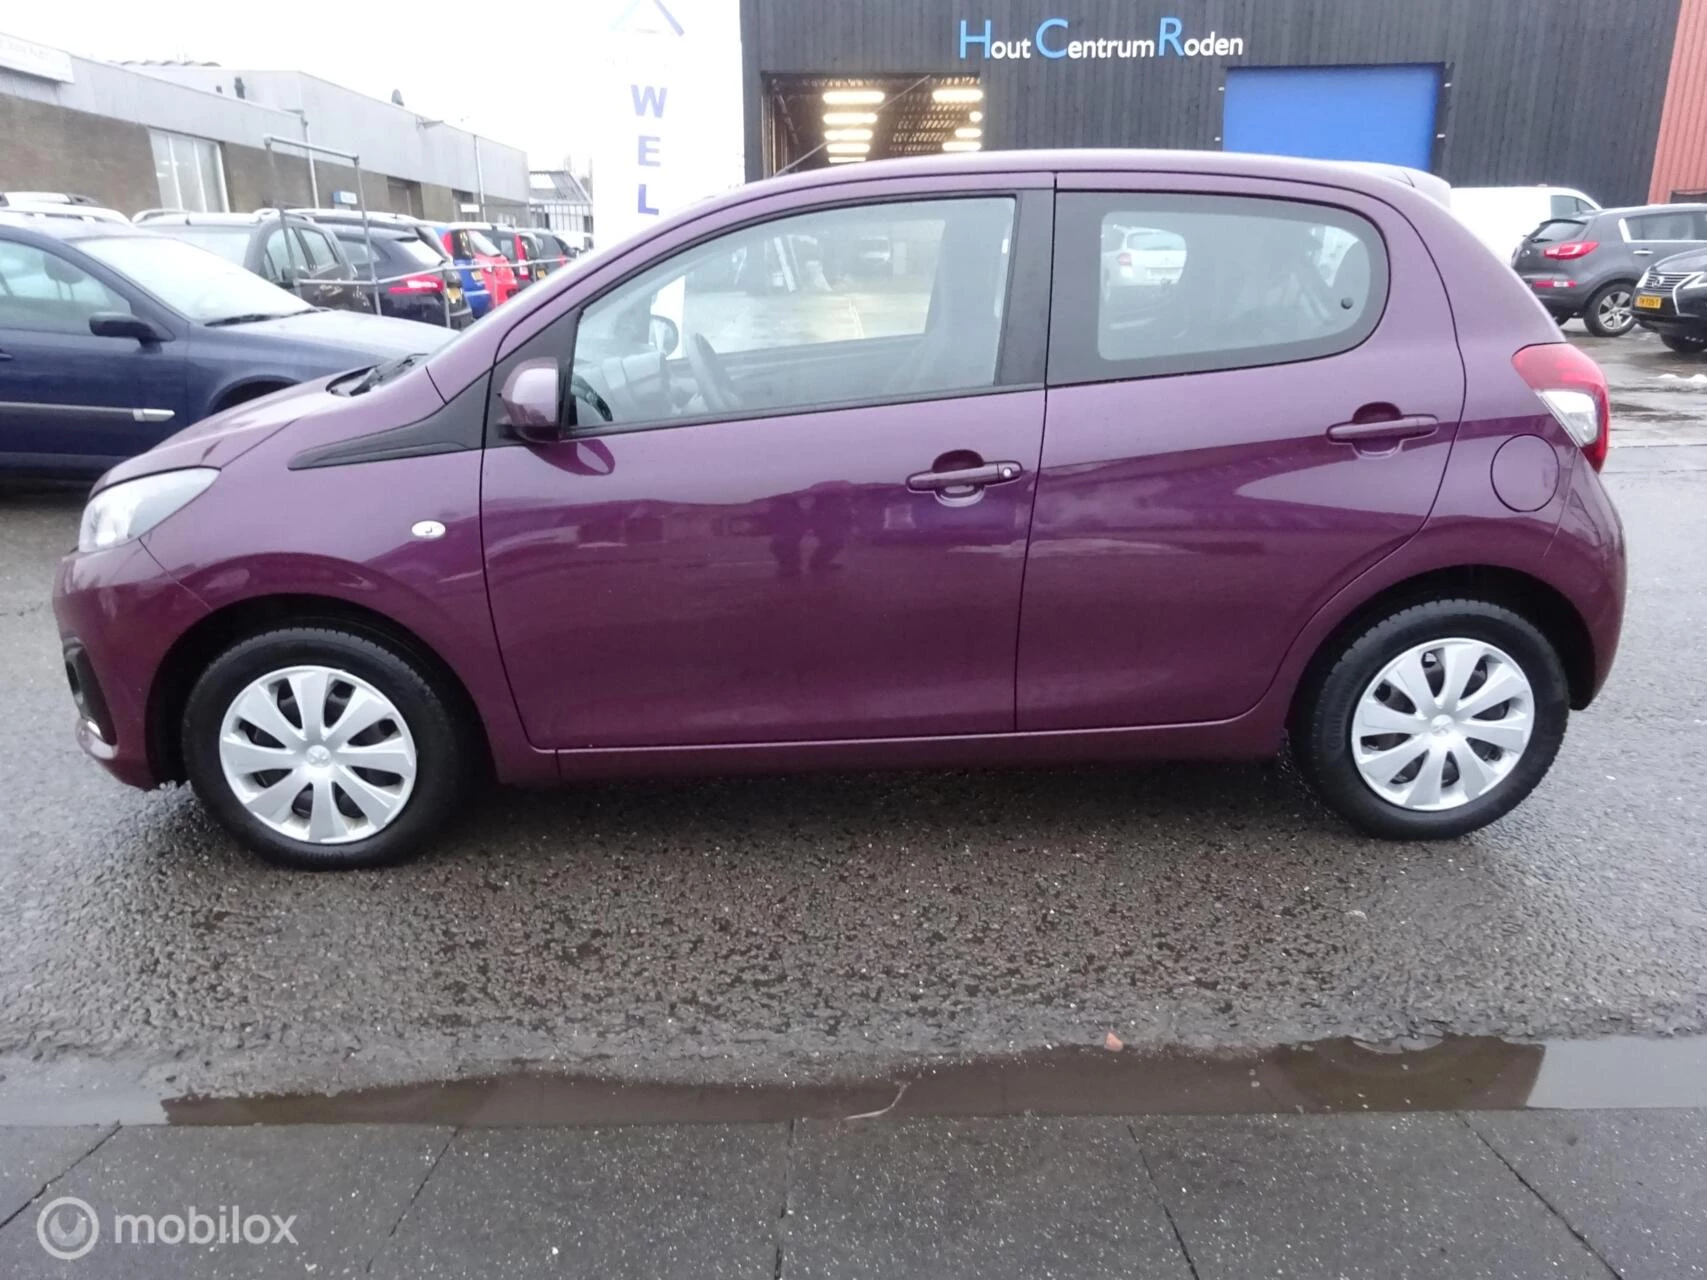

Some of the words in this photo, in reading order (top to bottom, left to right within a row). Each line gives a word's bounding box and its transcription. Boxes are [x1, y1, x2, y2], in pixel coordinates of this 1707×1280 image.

[959, 19, 1031, 60] Hout
[1035, 17, 1155, 60] Centrum
[1158, 16, 1244, 57] Roden
